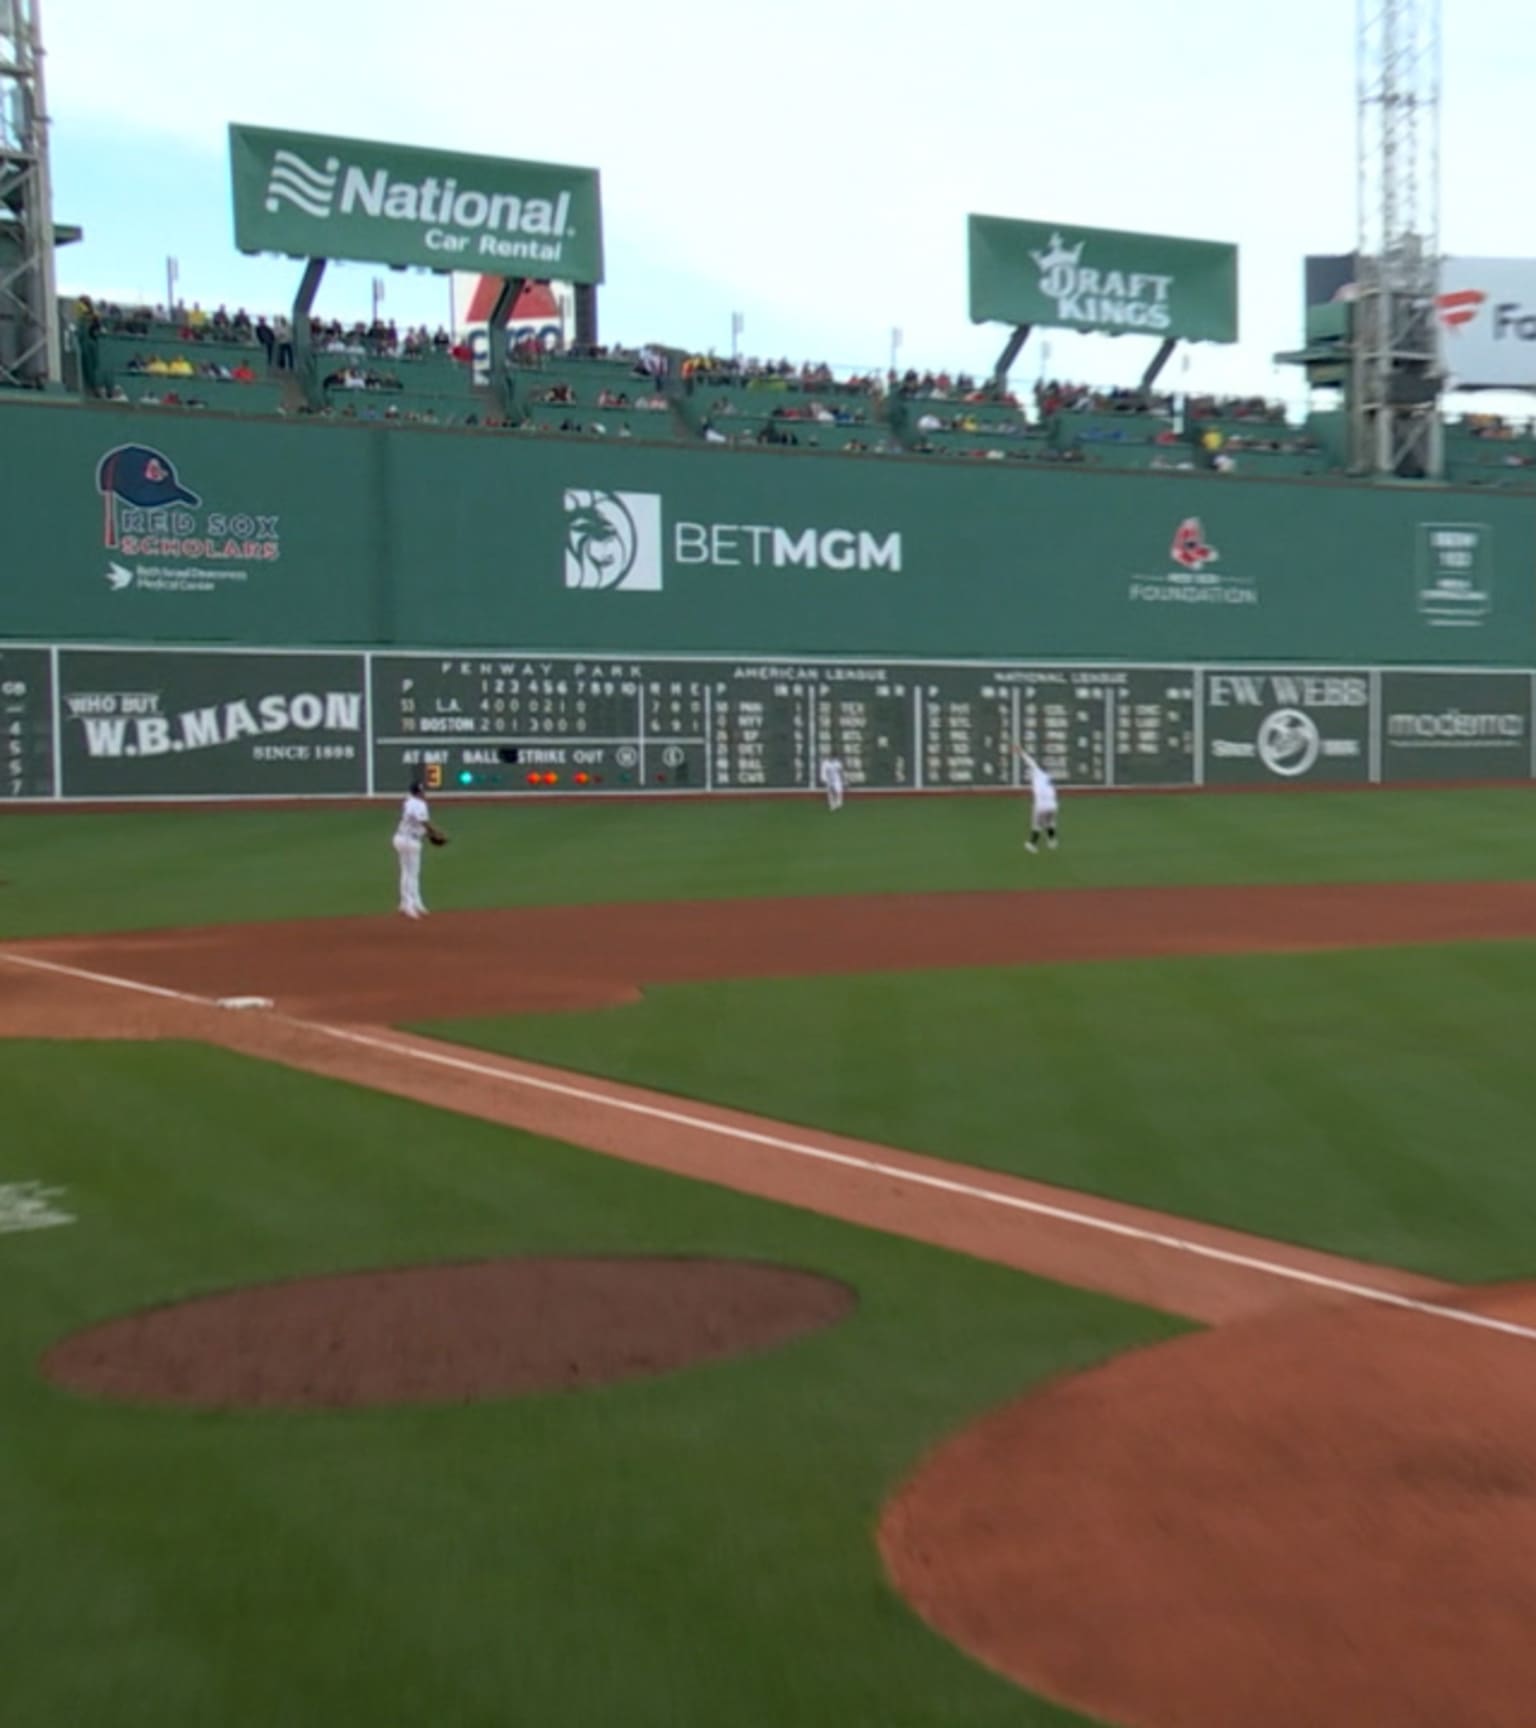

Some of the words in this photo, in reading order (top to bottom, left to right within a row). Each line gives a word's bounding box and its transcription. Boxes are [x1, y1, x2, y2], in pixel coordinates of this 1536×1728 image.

[339, 164, 573, 236] National
[424, 228, 471, 251] Car
[479, 234, 562, 262] Rental
[1039, 264, 1174, 301] DRAFT
[1057, 297, 1171, 329] KINGS
[121, 510, 196, 536] RED
[207, 513, 280, 540] SOX
[121, 535, 281, 561] SCHOLARS
[674, 521, 901, 572] BETMGM
[1129, 584, 1259, 604] FOUNDATION
[441, 661, 553, 676] FENWAY
[573, 662, 643, 678] PARK
[733, 666, 819, 680] AMERICAN
[825, 668, 887, 680] LEAGUE
[495, 679, 504, 693] 2
[528, 680, 538, 693] 4
[543, 680, 553, 694] 5
[557, 681, 567, 695] 6
[577, 681, 585, 694] 7
[1270, 675, 1368, 706] WEBB
[69, 697, 117, 713] WHO
[121, 697, 159, 713] BUT
[480, 698, 489, 712] 4
[420, 717, 474, 732] BOSTON
[253, 746, 310, 760] SINCE
[402, 750, 419, 763] AT
[423, 750, 448, 763] BAT
[462, 750, 500, 764] BALL
[517, 749, 567, 764] STRIKE
[573, 750, 604, 764] OUT
